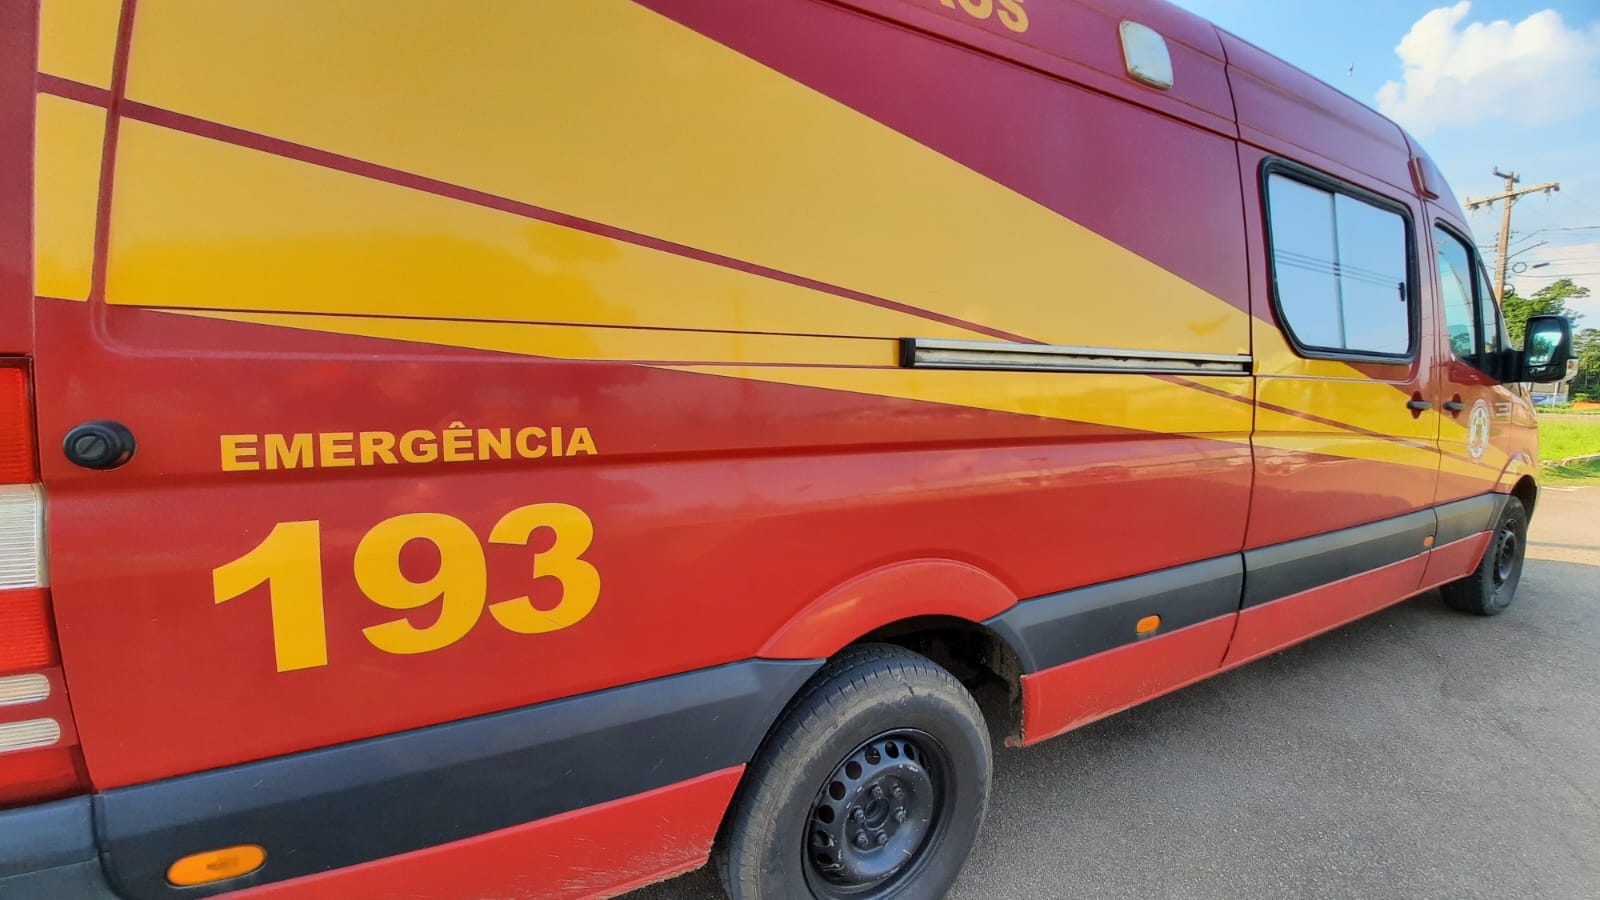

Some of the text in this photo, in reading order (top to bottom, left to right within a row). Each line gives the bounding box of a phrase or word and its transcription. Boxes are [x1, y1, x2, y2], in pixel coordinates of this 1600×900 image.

[940, 0, 1029, 33] OS
[220, 421, 598, 472] EMERGÊNCIA
[212, 502, 601, 673] 193
